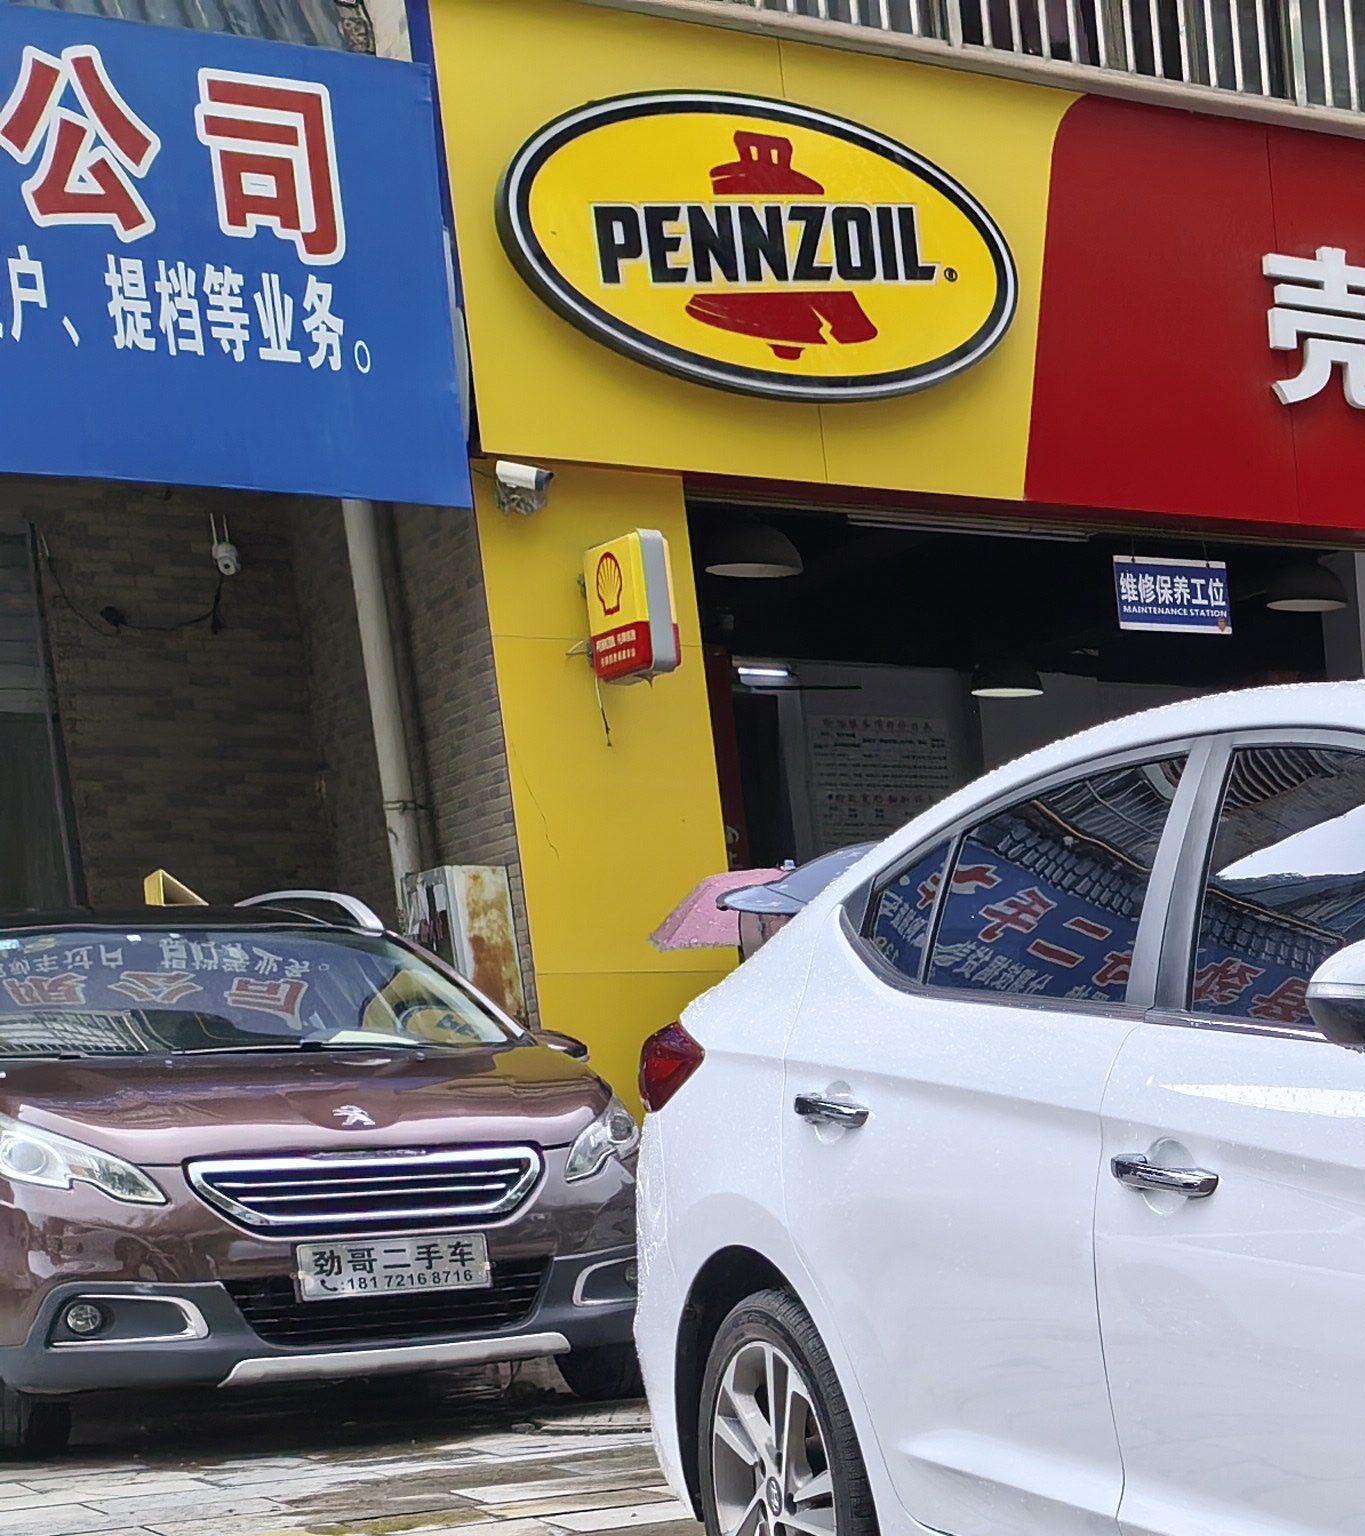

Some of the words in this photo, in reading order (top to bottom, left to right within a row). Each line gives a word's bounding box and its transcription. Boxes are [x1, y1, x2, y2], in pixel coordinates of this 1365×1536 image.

[0, 44, 346, 266] 公司
[591, 201, 940, 286] PENNZOIL
[0, 245, 371, 374] 户、提档等业务。
[1119, 572, 1227, 607] 维修保养工位
[1123, 605, 1188, 616] MAINTENANCE
[1189, 608, 1228, 618] STATION
[312, 1241, 476, 1278] 劲哥二手车
[384, 1272, 427, 1288] 7216
[432, 1269, 473, 1284] 8716
